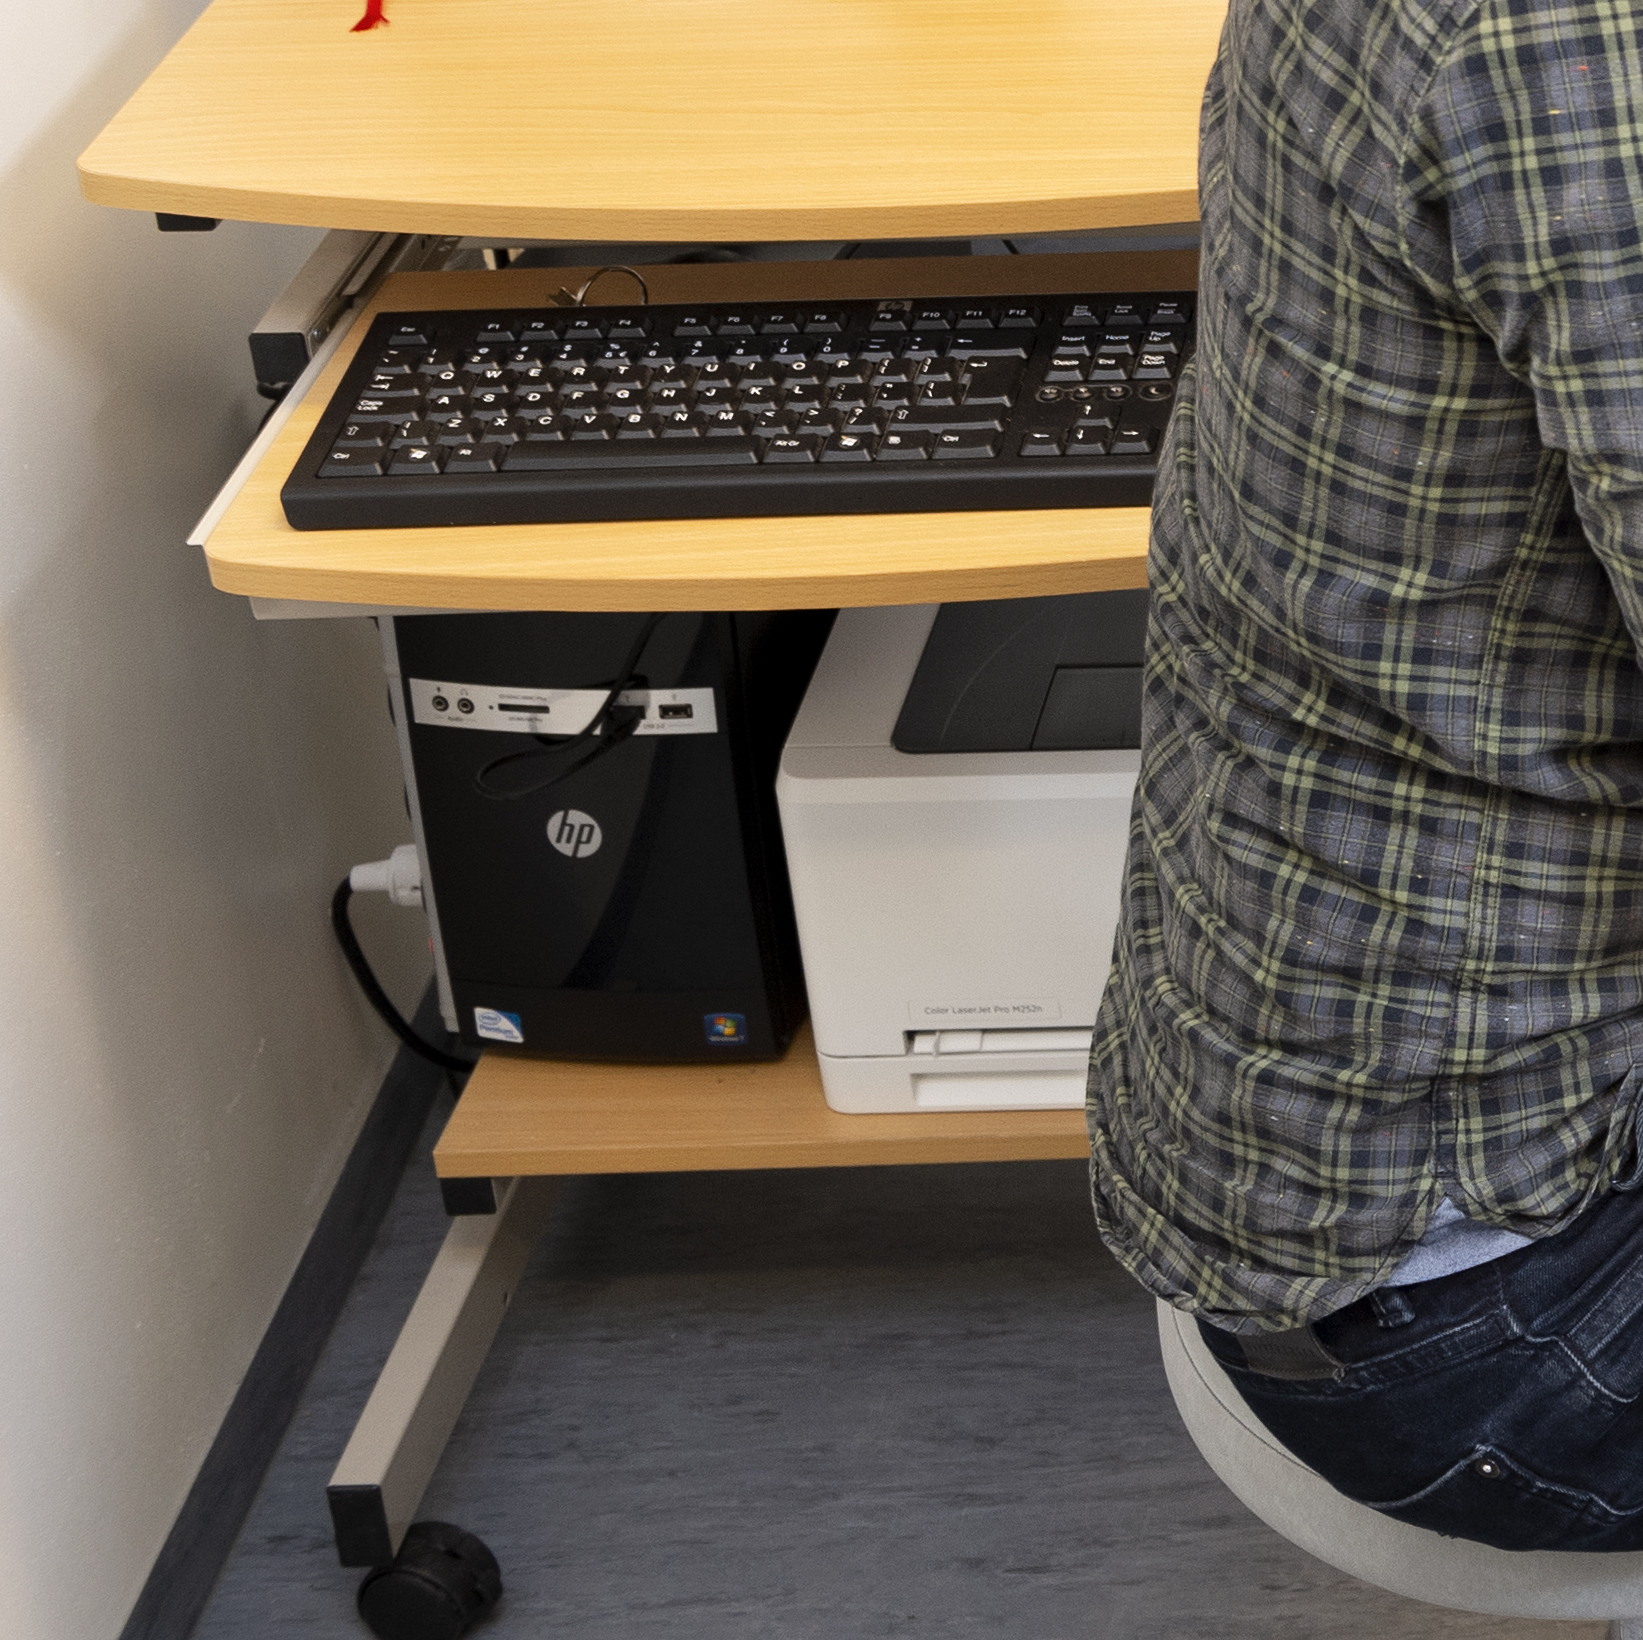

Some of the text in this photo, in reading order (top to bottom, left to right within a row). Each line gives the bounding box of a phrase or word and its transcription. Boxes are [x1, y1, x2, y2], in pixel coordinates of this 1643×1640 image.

[617, 364, 629, 374] T
[663, 364, 676, 374] Y
[704, 363, 719, 373] U
[791, 361, 806, 371] O
[836, 360, 849, 369] P
[440, 371, 454, 381] Q
[485, 369, 502, 379] W
[528, 367, 542, 377] E
[572, 367, 586, 376] R
[615, 388, 630, 399] G
[660, 388, 676, 398] H
[704, 387, 717, 397] J
[749, 386, 763, 396] K
[793, 385, 804, 395] L
[437, 395, 450, 405] A
[482, 393, 496, 403] S
[527, 392, 541, 402] D
[571, 391, 584, 400] F
[538, 416, 552, 426] C
[583, 414, 597, 424] V
[627, 413, 641, 424] B
[674, 411, 689, 422] N
[719, 411, 735, 421] M
[448, 418, 463, 428] Z
[494, 417, 508, 427] X
[553, 808, 597, 859] hp
[924, 1006, 949, 1015] Color
[952, 1006, 991, 1014] LaserJet
[994, 1005, 1010, 1014] Pro
